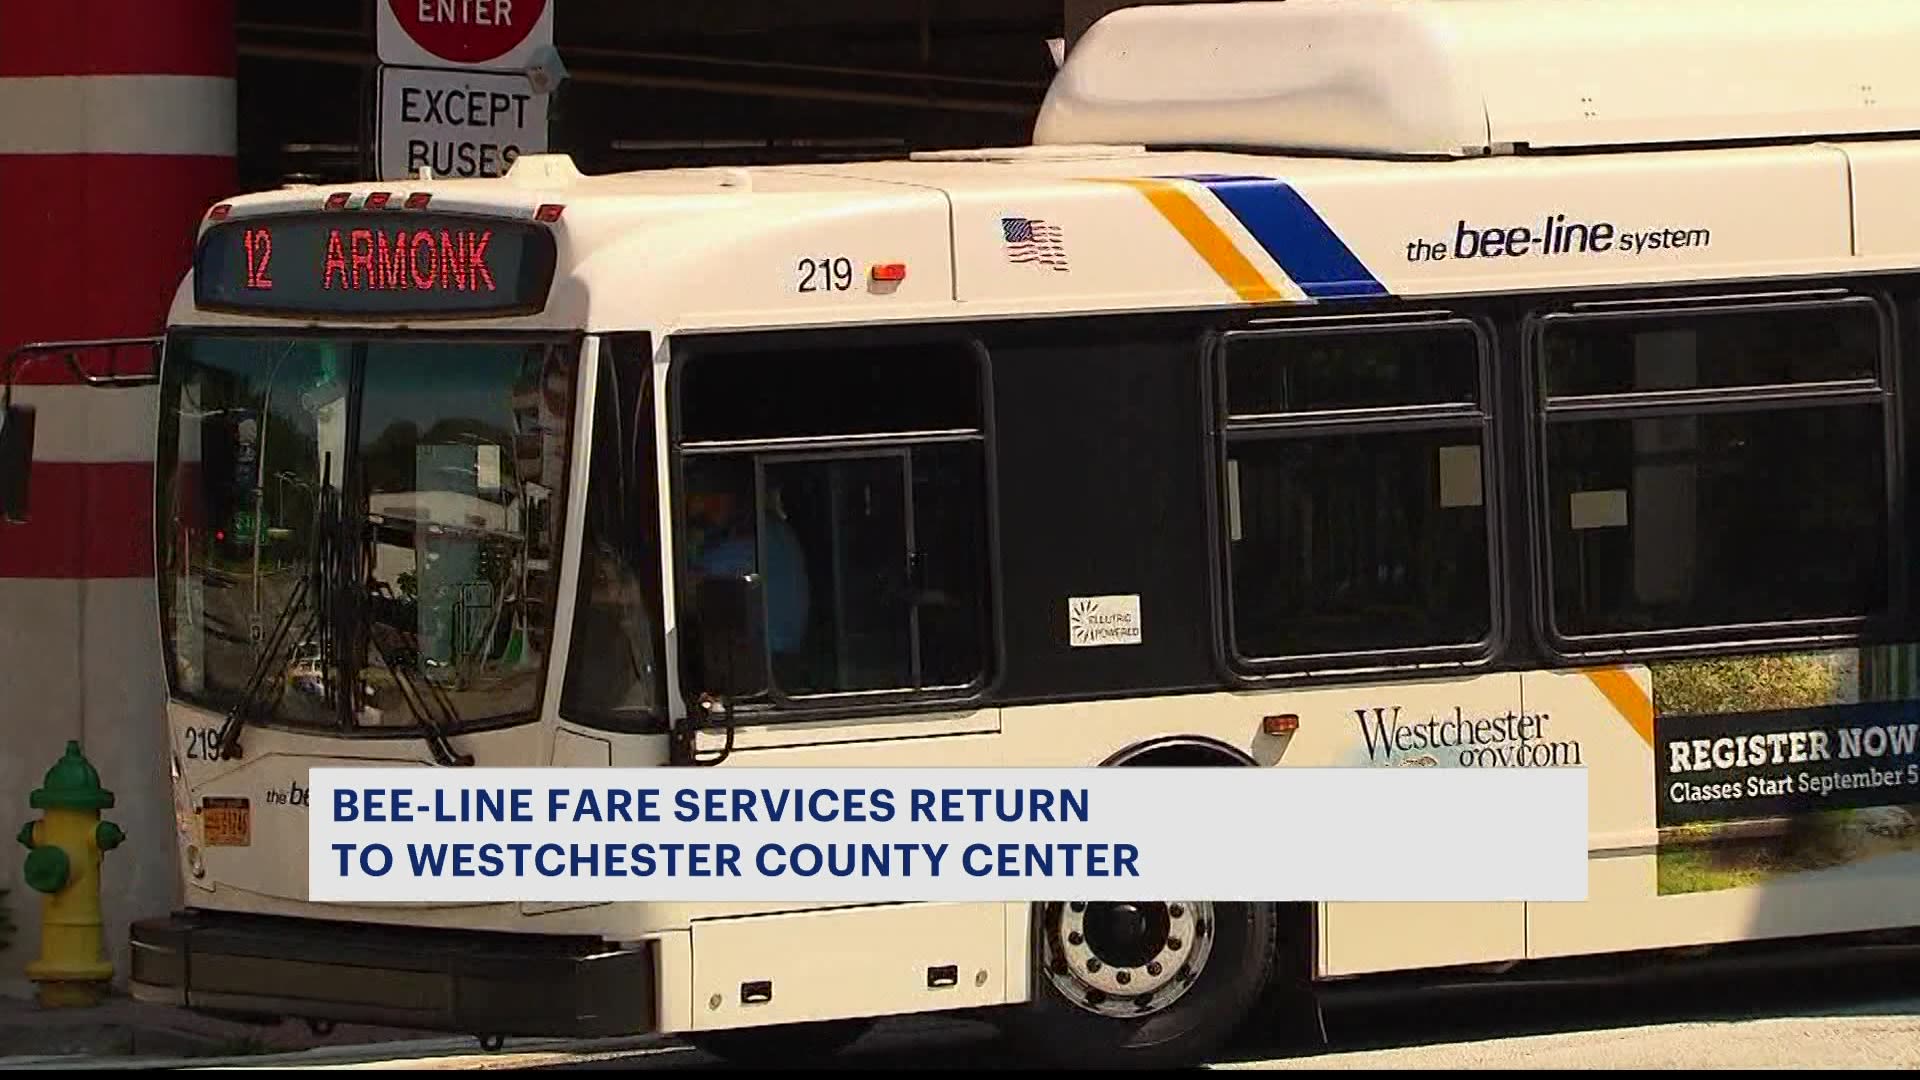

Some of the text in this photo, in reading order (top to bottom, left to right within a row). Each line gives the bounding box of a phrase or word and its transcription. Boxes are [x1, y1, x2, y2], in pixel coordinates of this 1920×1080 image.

[418, 0, 512, 26] ENTER
[401, 87, 531, 128] EXCEPT
[408, 140, 521, 178] BUSES
[1406, 214, 1710, 262] the bee-line system
[244, 228, 496, 291] 12 ARMONK
[798, 256, 852, 292] 219
[186, 726, 220, 761] 219
[1354, 706, 1549, 761] Westchester
[1669, 723, 1919, 773] REGISTER NOW
[266, 790, 287, 805] the
[1670, 763, 1919, 803] Classes Start September 5
